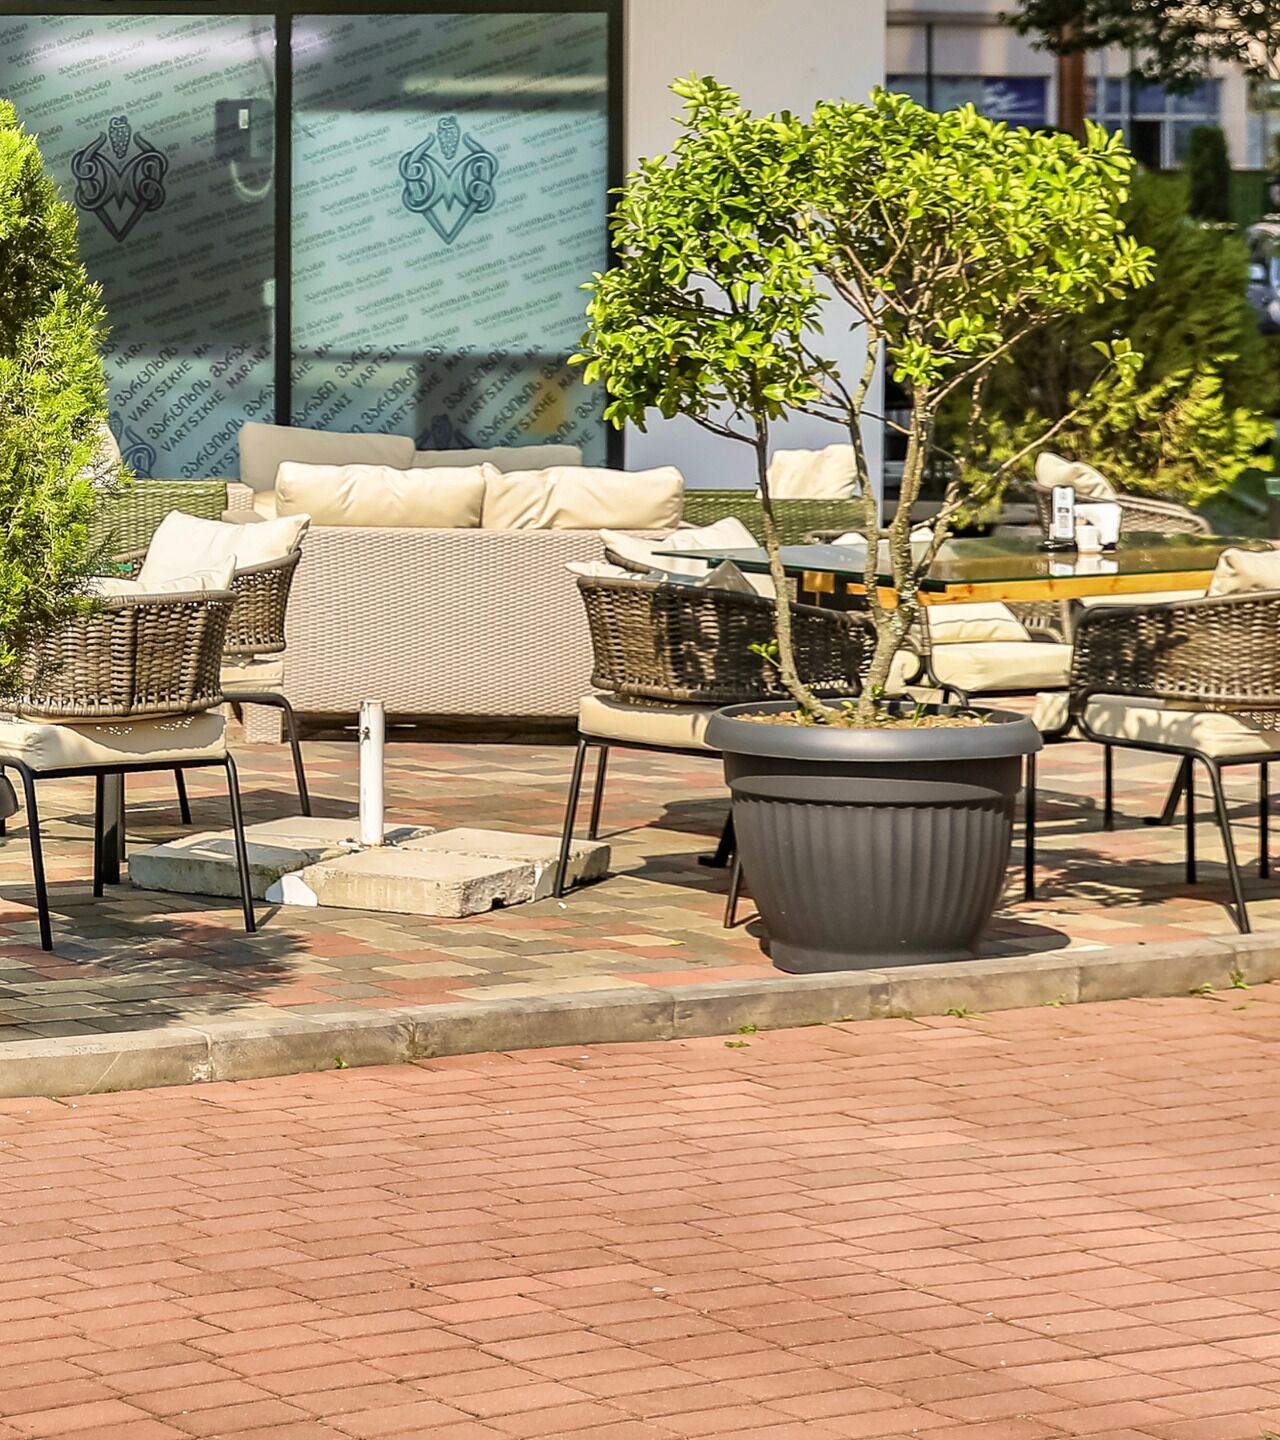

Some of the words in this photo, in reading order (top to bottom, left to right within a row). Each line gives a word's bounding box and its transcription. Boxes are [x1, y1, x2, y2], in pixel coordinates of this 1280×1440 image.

[113, 340, 179, 407] ვარციხის
[127, 359, 192, 422] VARTSIKHE
[160, 389, 226, 452] VARTSIKHE
[226, 345, 272, 389] MARANI
[360, 358, 427, 426] ვარციხის
[377, 374, 442, 435] VARTSIKHE
[458, 360, 524, 425] VARTSIKHE
[146, 379, 212, 440] ვარციხის
[310, 393, 353, 432] ARANI
[477, 382, 543, 443] ვარციხის
[179, 418, 245, 480] ვარციხის
